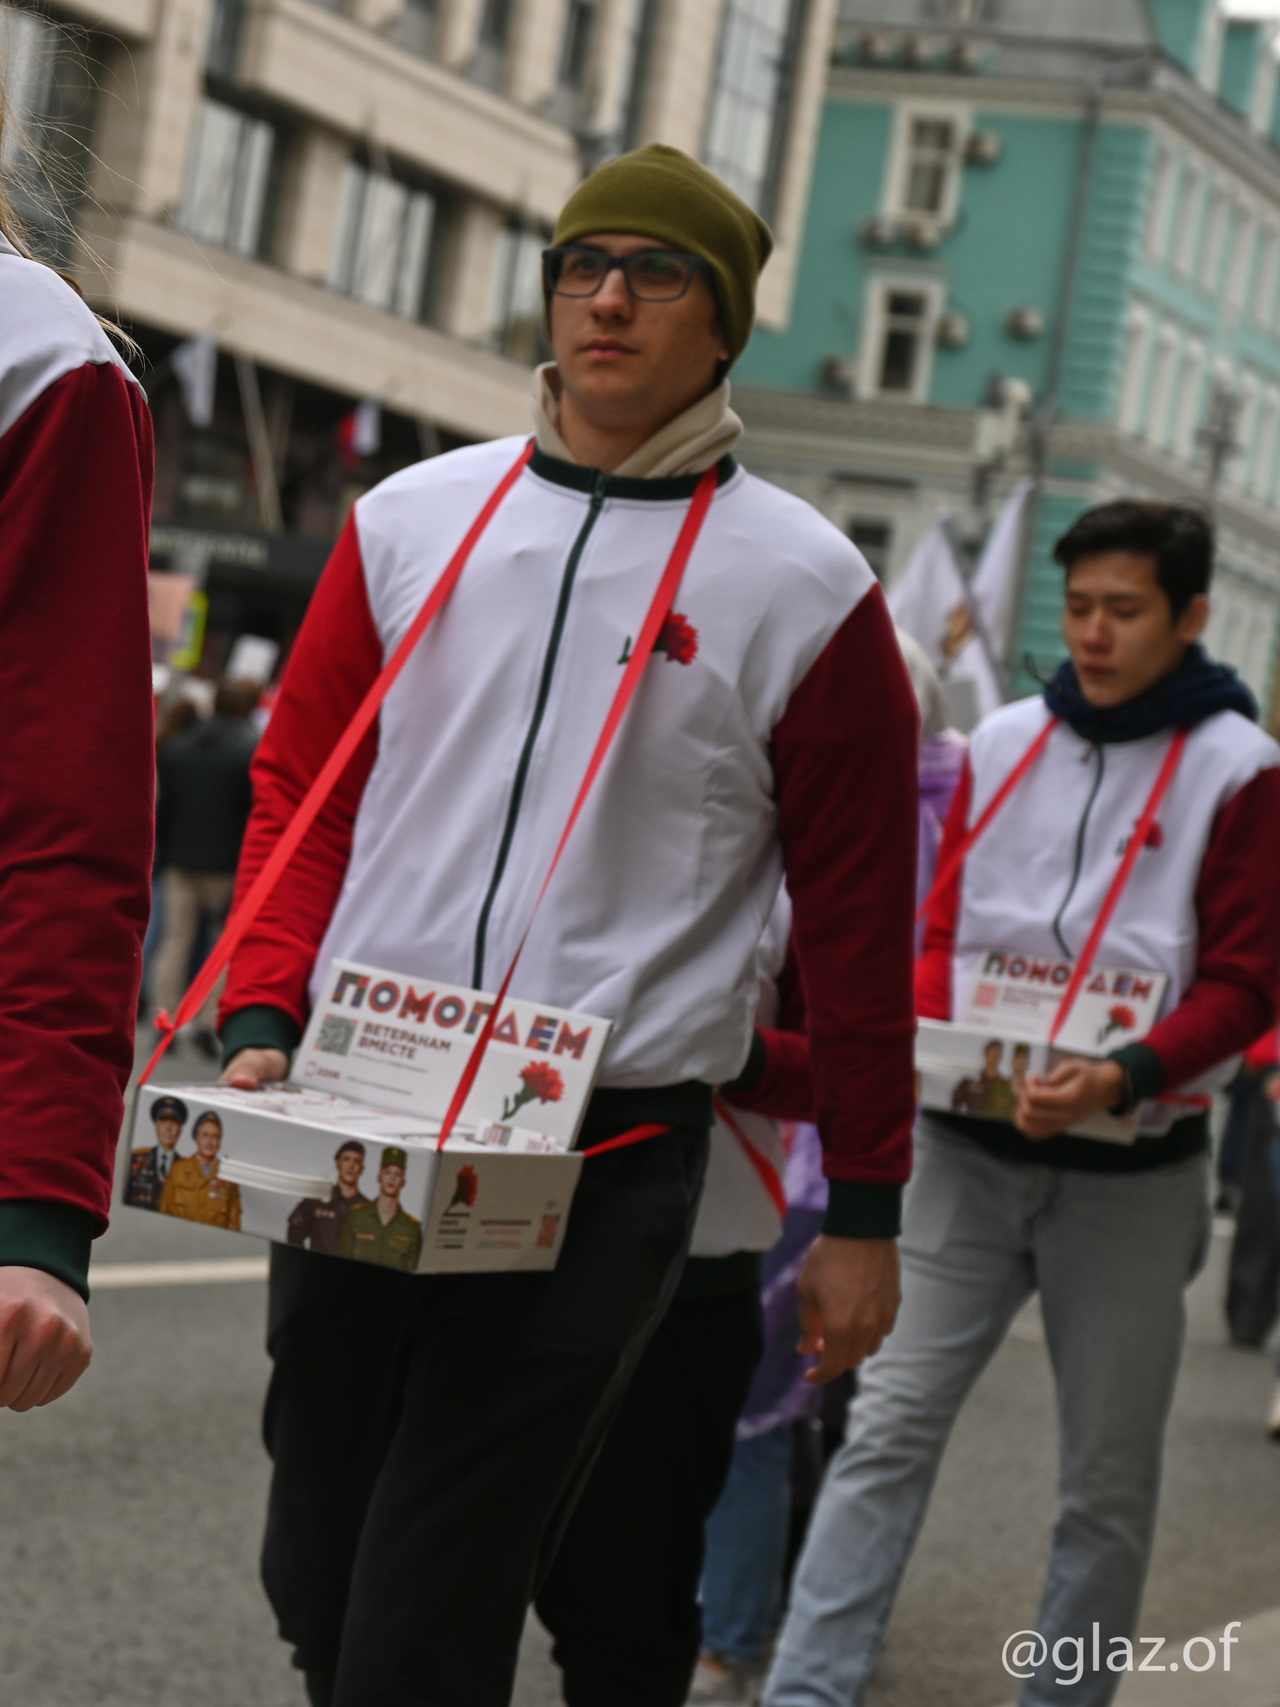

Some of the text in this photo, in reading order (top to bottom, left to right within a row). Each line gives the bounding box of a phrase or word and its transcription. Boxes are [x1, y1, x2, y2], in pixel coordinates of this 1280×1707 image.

[982, 952, 1154, 1002] ПОМОАЕМ
[331, 970, 592, 1061] ПОМОГАЕМ
[358, 1037, 417, 1060] ВМЕСТЕ
[362, 1022, 452, 1053] ВЕТЕРАНАМ
